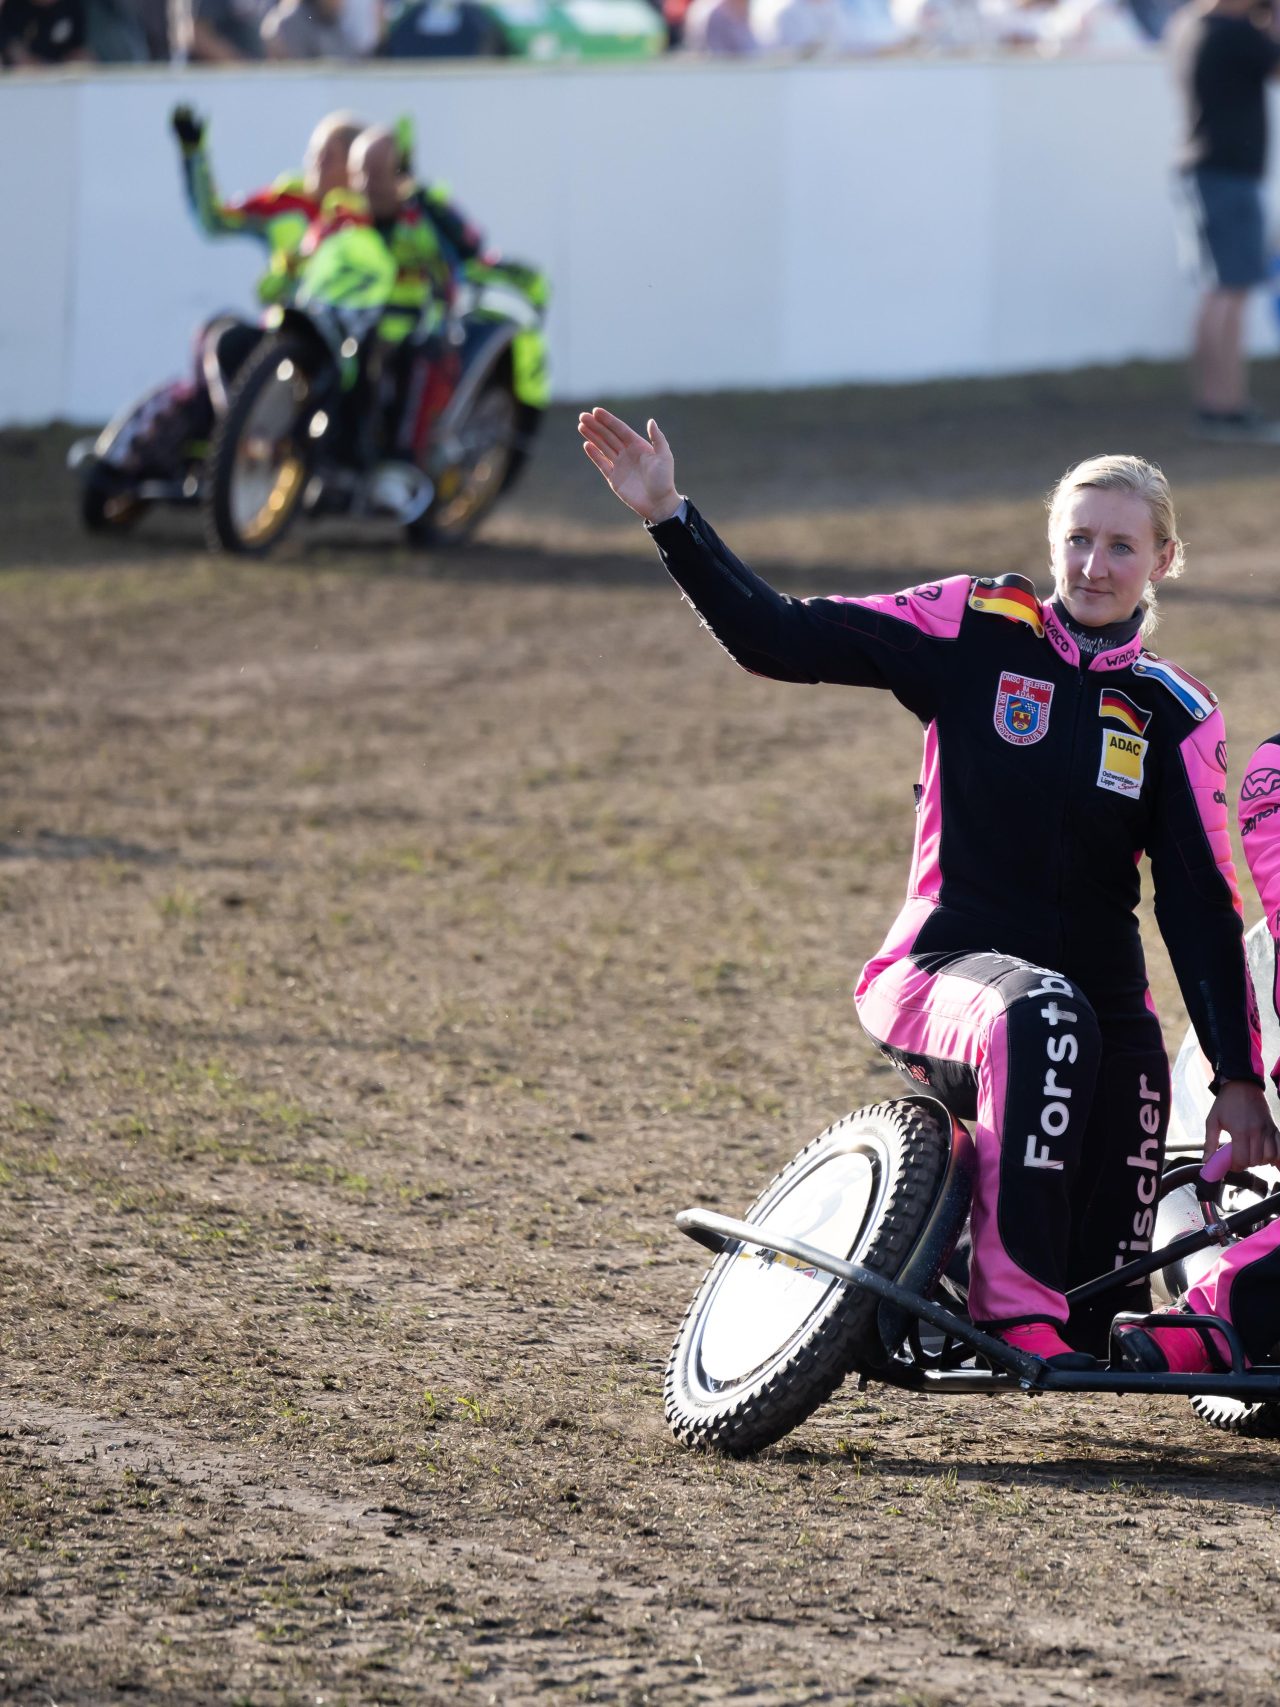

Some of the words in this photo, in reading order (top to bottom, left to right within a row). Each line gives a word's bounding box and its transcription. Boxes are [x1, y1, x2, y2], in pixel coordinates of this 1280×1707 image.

[1044, 617, 1070, 652] WACO
[1106, 649, 1134, 667] WACO
[1015, 690, 1035, 700] ADAC
[1109, 736, 1142, 757] ADAC
